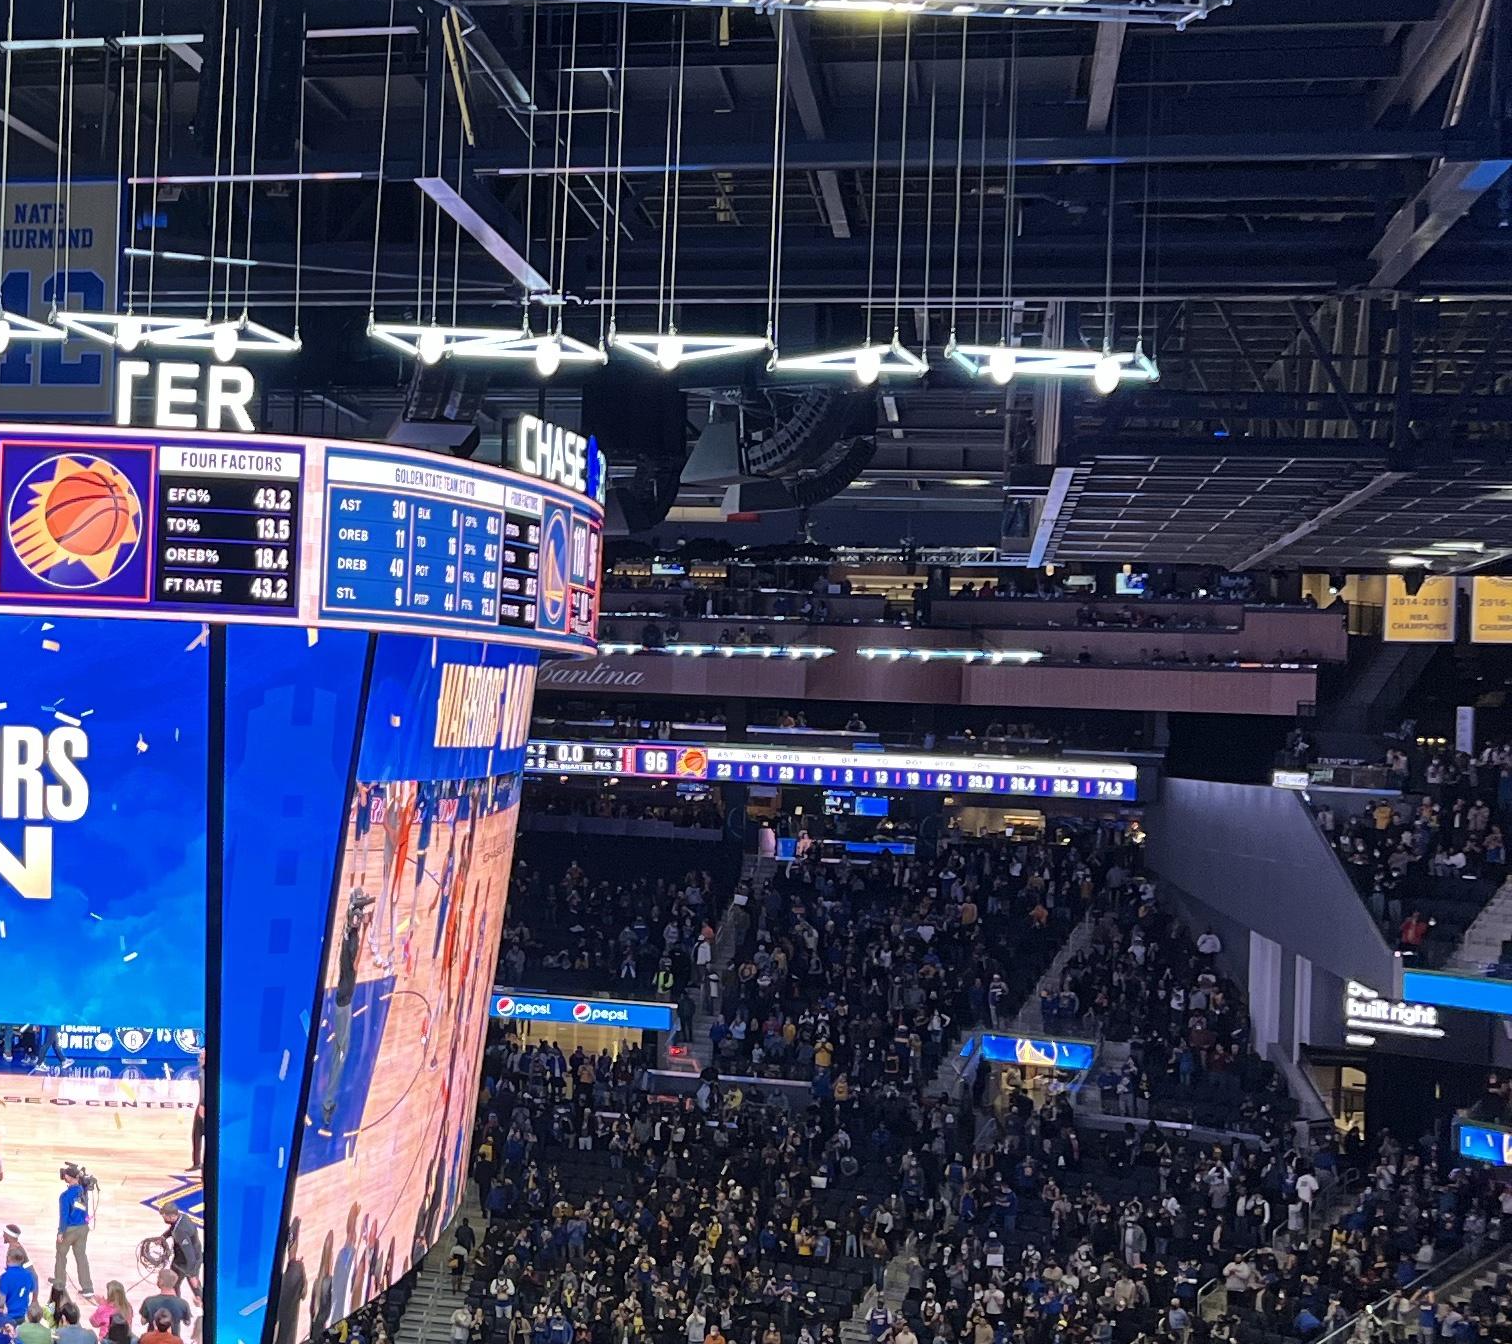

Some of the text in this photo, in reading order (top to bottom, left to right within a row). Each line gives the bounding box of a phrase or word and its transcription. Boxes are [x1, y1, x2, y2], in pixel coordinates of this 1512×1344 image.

[13, 203, 67, 225] NATE
[181, 452, 282, 473] FOUR FACTORS
[518, 414, 587, 492] CHASE
[395, 467, 424, 487] GOLDEN
[424, 472, 443, 492] STATE
[444, 476, 458, 495] TEAM
[167, 487, 292, 511] EFG% 43.2
[339, 499, 407, 520] AST 30
[166, 518, 290, 540] TO% 13.5
[338, 528, 405, 549] OREB 11
[165, 547, 289, 570] OREB% 18.4
[337, 557, 404, 578] DREB 40
[164, 577, 288, 601] FT RATE 43.2
[336, 587, 403, 607] STL 9
[444, 593, 454, 612] 44
[1392, 622, 1448, 631] CHAMPIONS
[538, 659, 646, 686] Cantina
[433, 662, 507, 749] WARRIORS
[557, 744, 584, 762] 0.0
[594, 747, 614, 757] TOL
[644, 751, 668, 772] 96
[874, 770, 889, 785] 13
[936, 772, 953, 788] 42
[1096, 780, 1124, 796] 74.3
[515, 1003, 551, 1016] pepsi
[591, 1009, 629, 1022] pepsi
[1346, 997, 1438, 1025] built right
[85, 1099, 194, 1109] CENTER
